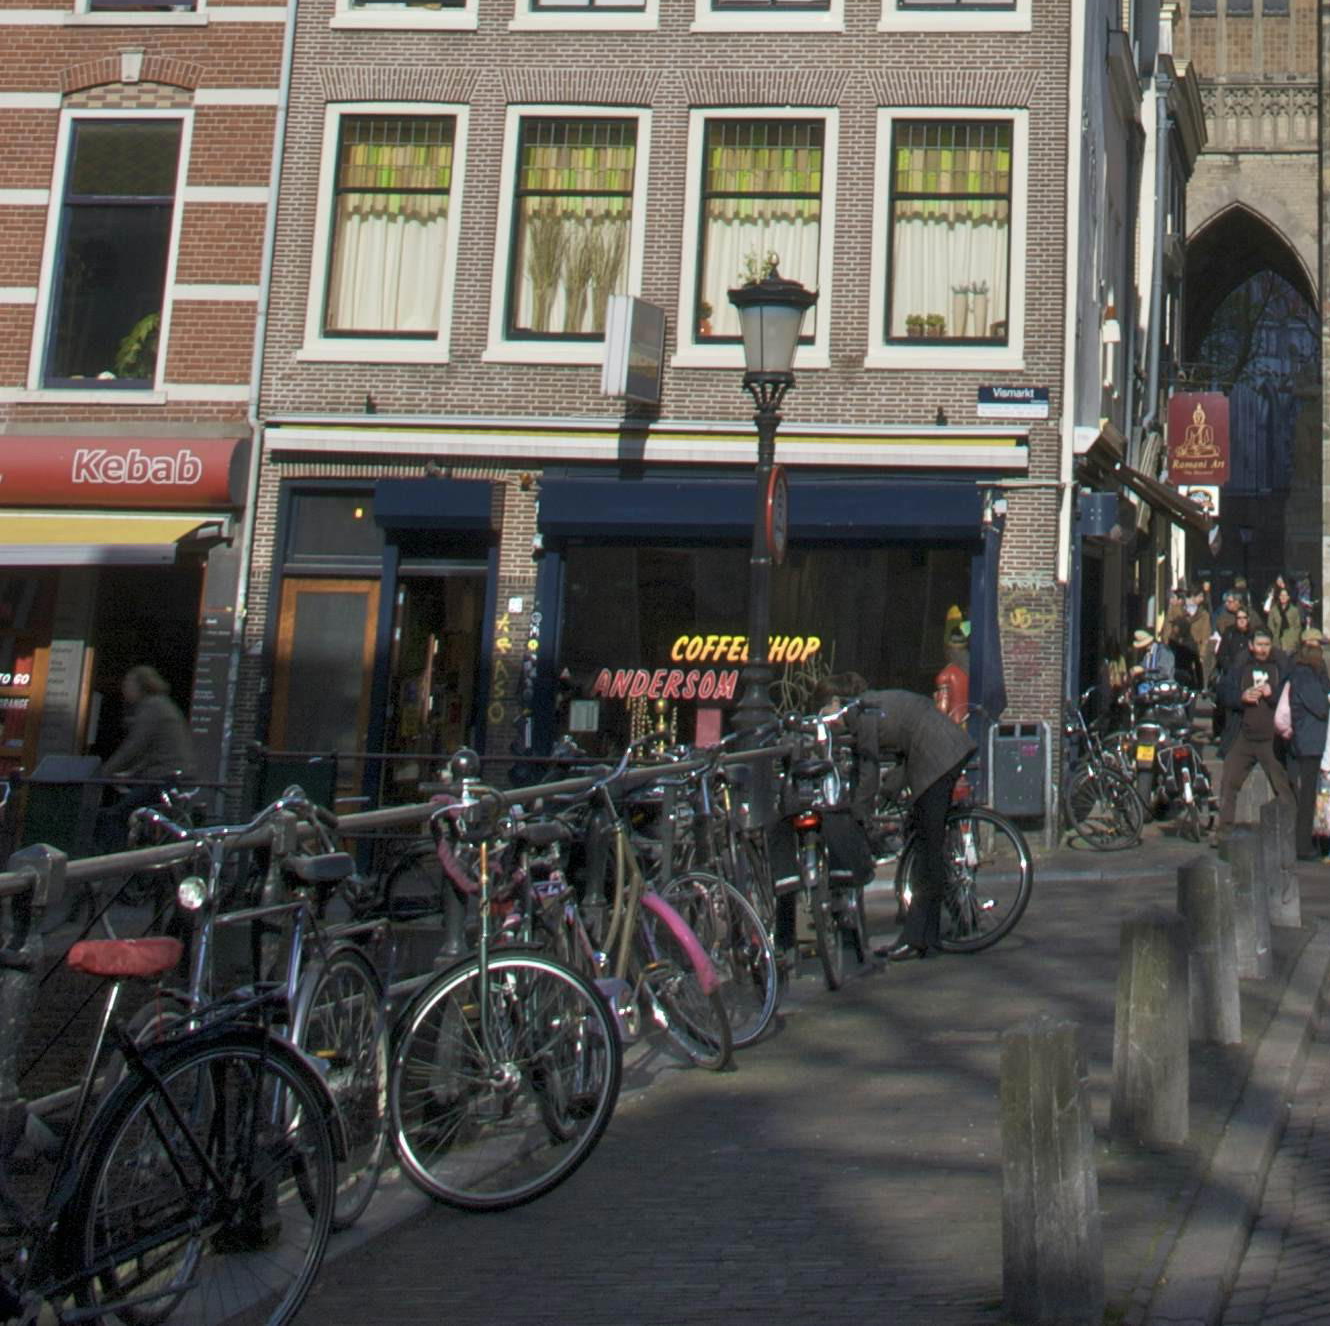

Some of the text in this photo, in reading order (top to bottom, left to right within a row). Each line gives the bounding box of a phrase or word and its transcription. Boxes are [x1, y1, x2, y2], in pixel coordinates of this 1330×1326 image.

[993, 388, 1034, 397] Vismarkt
[72, 449, 202, 484] Kebab
[671, 635, 821, 662] COFFEHOP
[13, 673, 30, 684] GO
[593, 668, 739, 699] ANDERSOM
